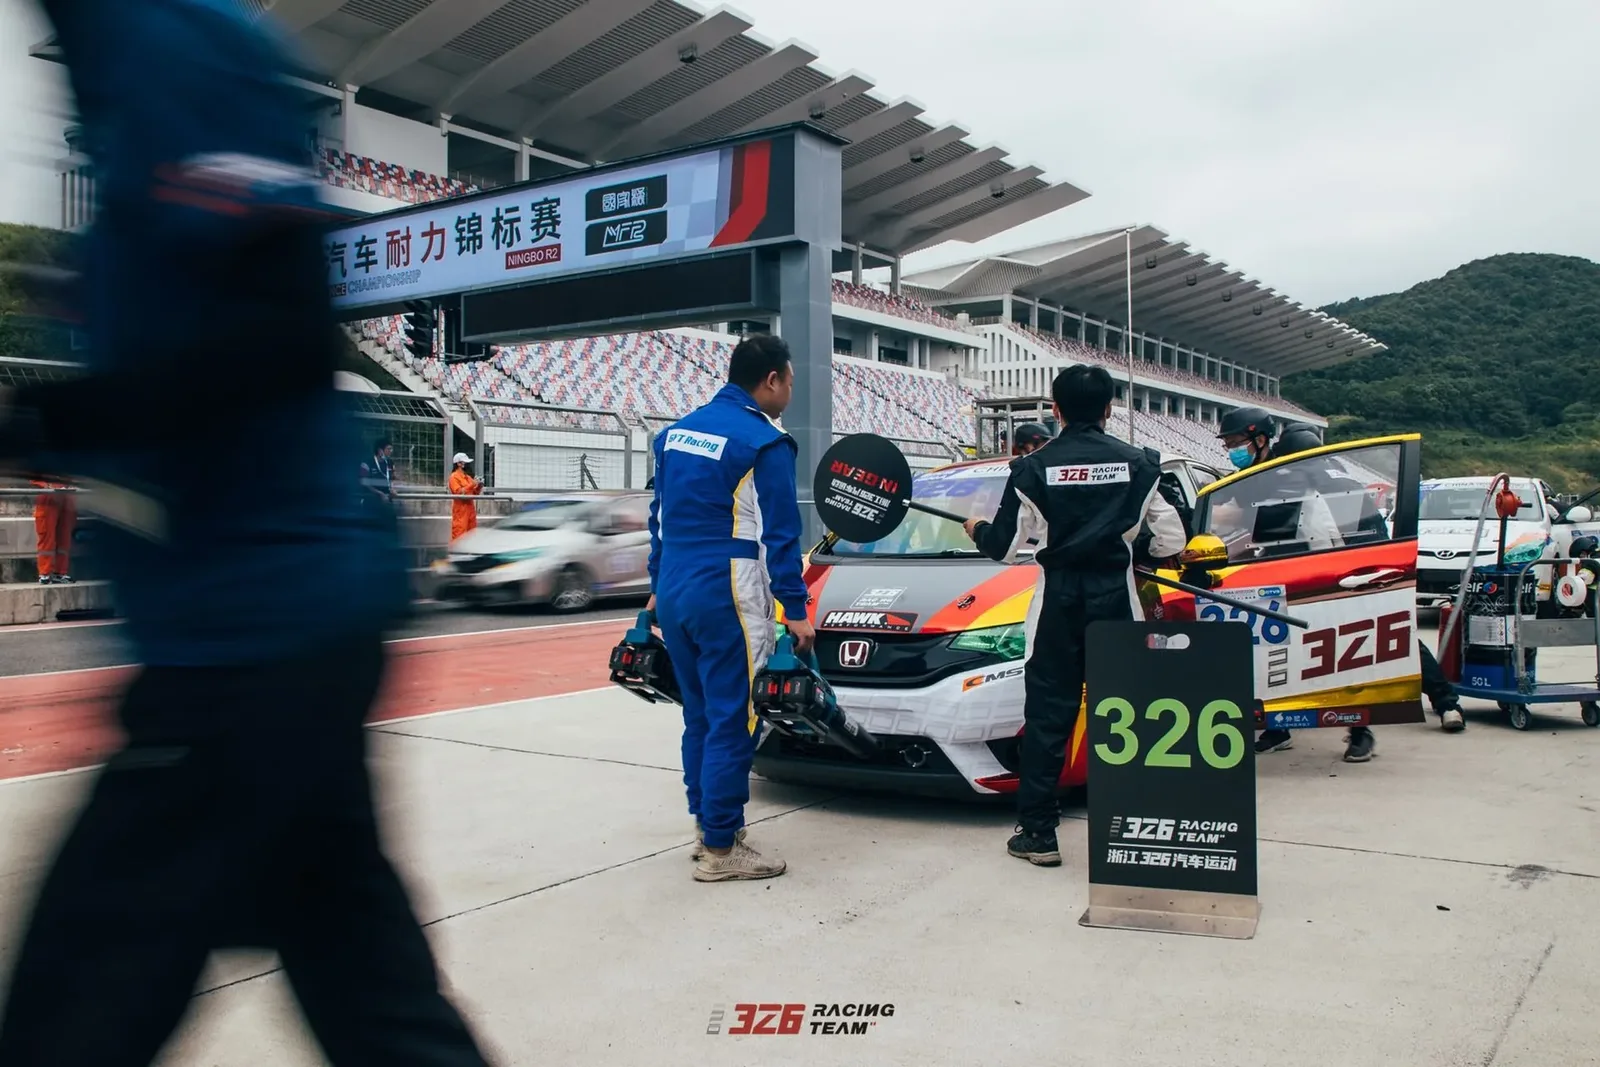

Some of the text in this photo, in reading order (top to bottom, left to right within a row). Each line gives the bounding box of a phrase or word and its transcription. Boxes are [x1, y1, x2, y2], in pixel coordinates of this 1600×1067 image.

[507, 247, 558, 266] NINGBO R2
[347, 269, 421, 294] CHAMPIONSHIP
[684, 436, 719, 453] Racing
[830, 460, 898, 494] IN GEAR
[1058, 465, 1127, 482] 326 RACING
[824, 497, 879, 522] 326 RACING
[833, 494, 854, 506] TEAM
[1466, 582, 1483, 593] elf
[825, 611, 887, 625] HAWK
[1301, 610, 1411, 681] 326
[1094, 696, 1246, 770] 326
[1122, 817, 1239, 841] 326 RACING
[1177, 832, 1220, 844] TEAM
[1106, 849, 1238, 872] 浙江326汽车运动
